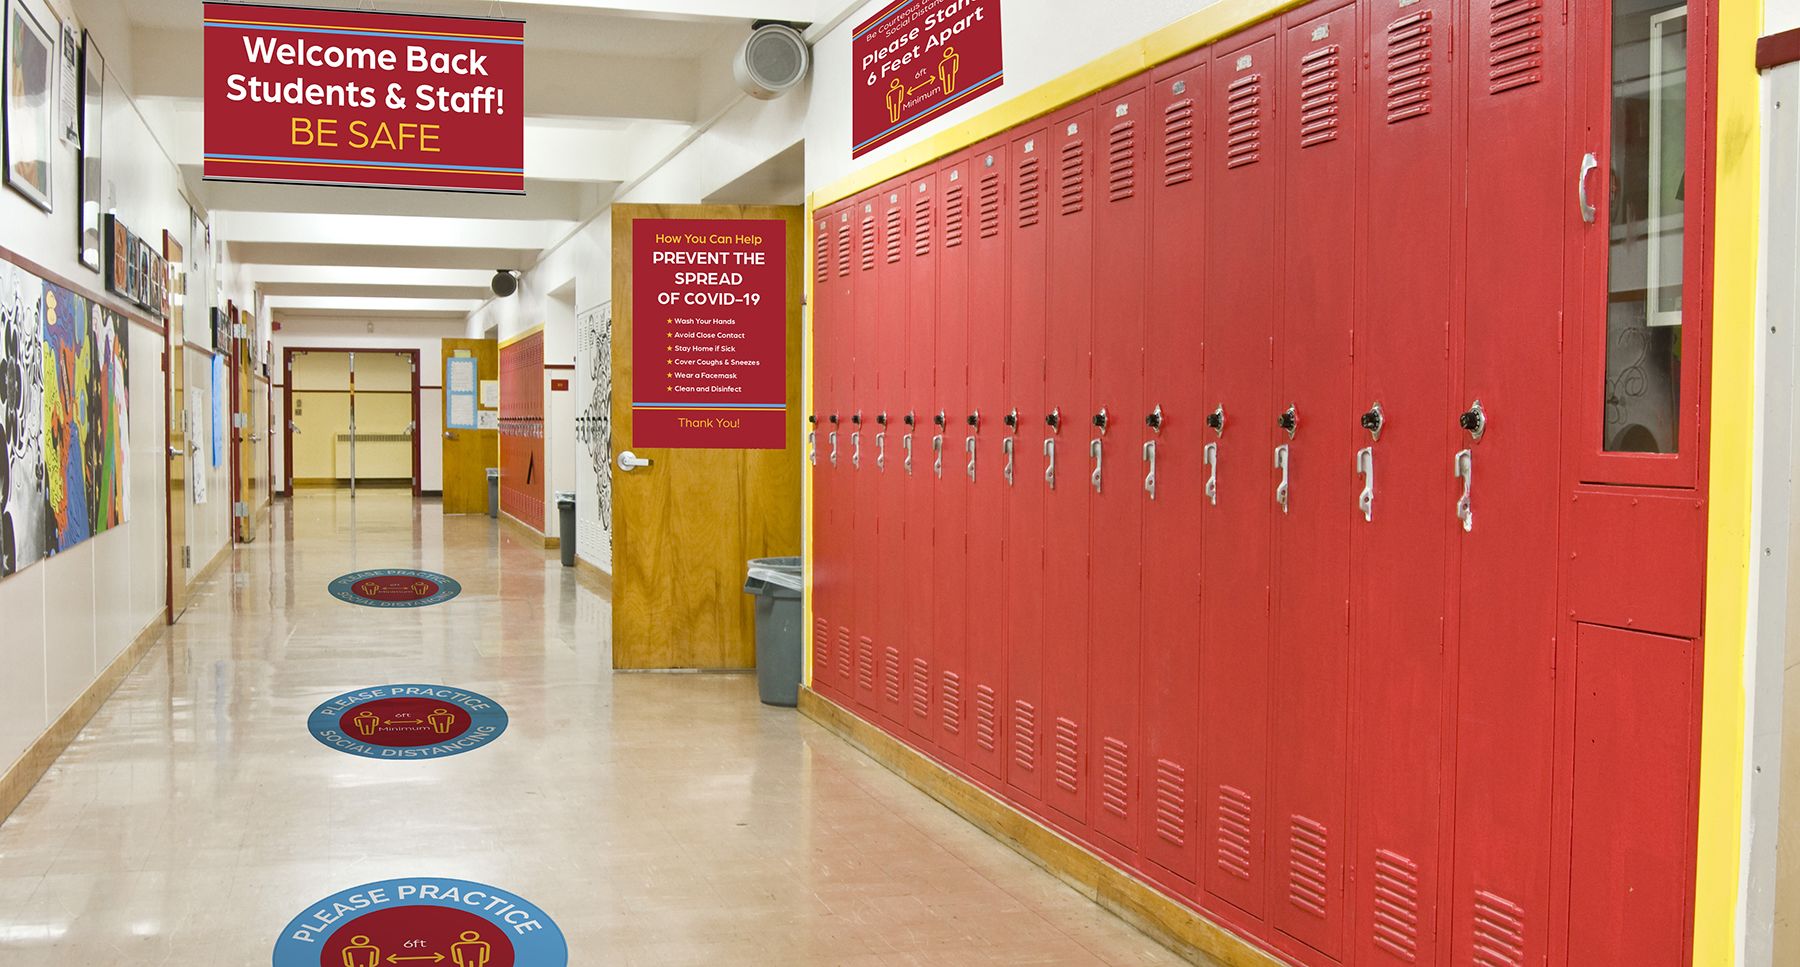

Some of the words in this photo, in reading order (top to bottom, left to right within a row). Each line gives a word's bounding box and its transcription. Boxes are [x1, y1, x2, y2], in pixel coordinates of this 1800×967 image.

[866, 31, 877, 42] Be
[878, 2, 920, 33] Courteous
[885, 18, 910, 38] Social
[862, 27, 920, 71] Please
[924, 0, 977, 31] Stan
[867, 72, 877, 86] 6
[881, 44, 920, 78] Feet
[924, 6, 984, 53] Apart
[242, 35, 397, 70] Welcome
[406, 45, 489, 76] Back
[914, 67, 927, 80] 6ft
[226, 74, 376, 108] Students
[384, 82, 407, 110] &
[415, 84, 504, 115] Staff!
[903, 86, 941, 112] Minimum
[291, 117, 338, 147] BE
[348, 121, 441, 152] SAFE
[655, 233, 682, 244] How
[684, 233, 707, 244] You
[709, 234, 732, 244] Can
[735, 234, 762, 246] Help
[653, 251, 730, 265] PREVENT
[733, 252, 765, 265] THE
[674, 272, 743, 286] SPREAD
[657, 292, 680, 305] OF
[674, 345, 691, 353] Stay
[674, 358, 695, 366] Cover
[696, 359, 723, 367] Coughs
[678, 417, 713, 428] Thank
[716, 418, 740, 429] You!
[321, 689, 383, 716] PLEASE
[391, 687, 490, 711] PRACTICE
[320, 729, 375, 755] SOCIAL
[381, 725, 497, 757] DISTANCING
[292, 888, 390, 943] PLEASE
[398, 884, 542, 935] PRACTICE
[403, 938, 427, 949] 6ft
